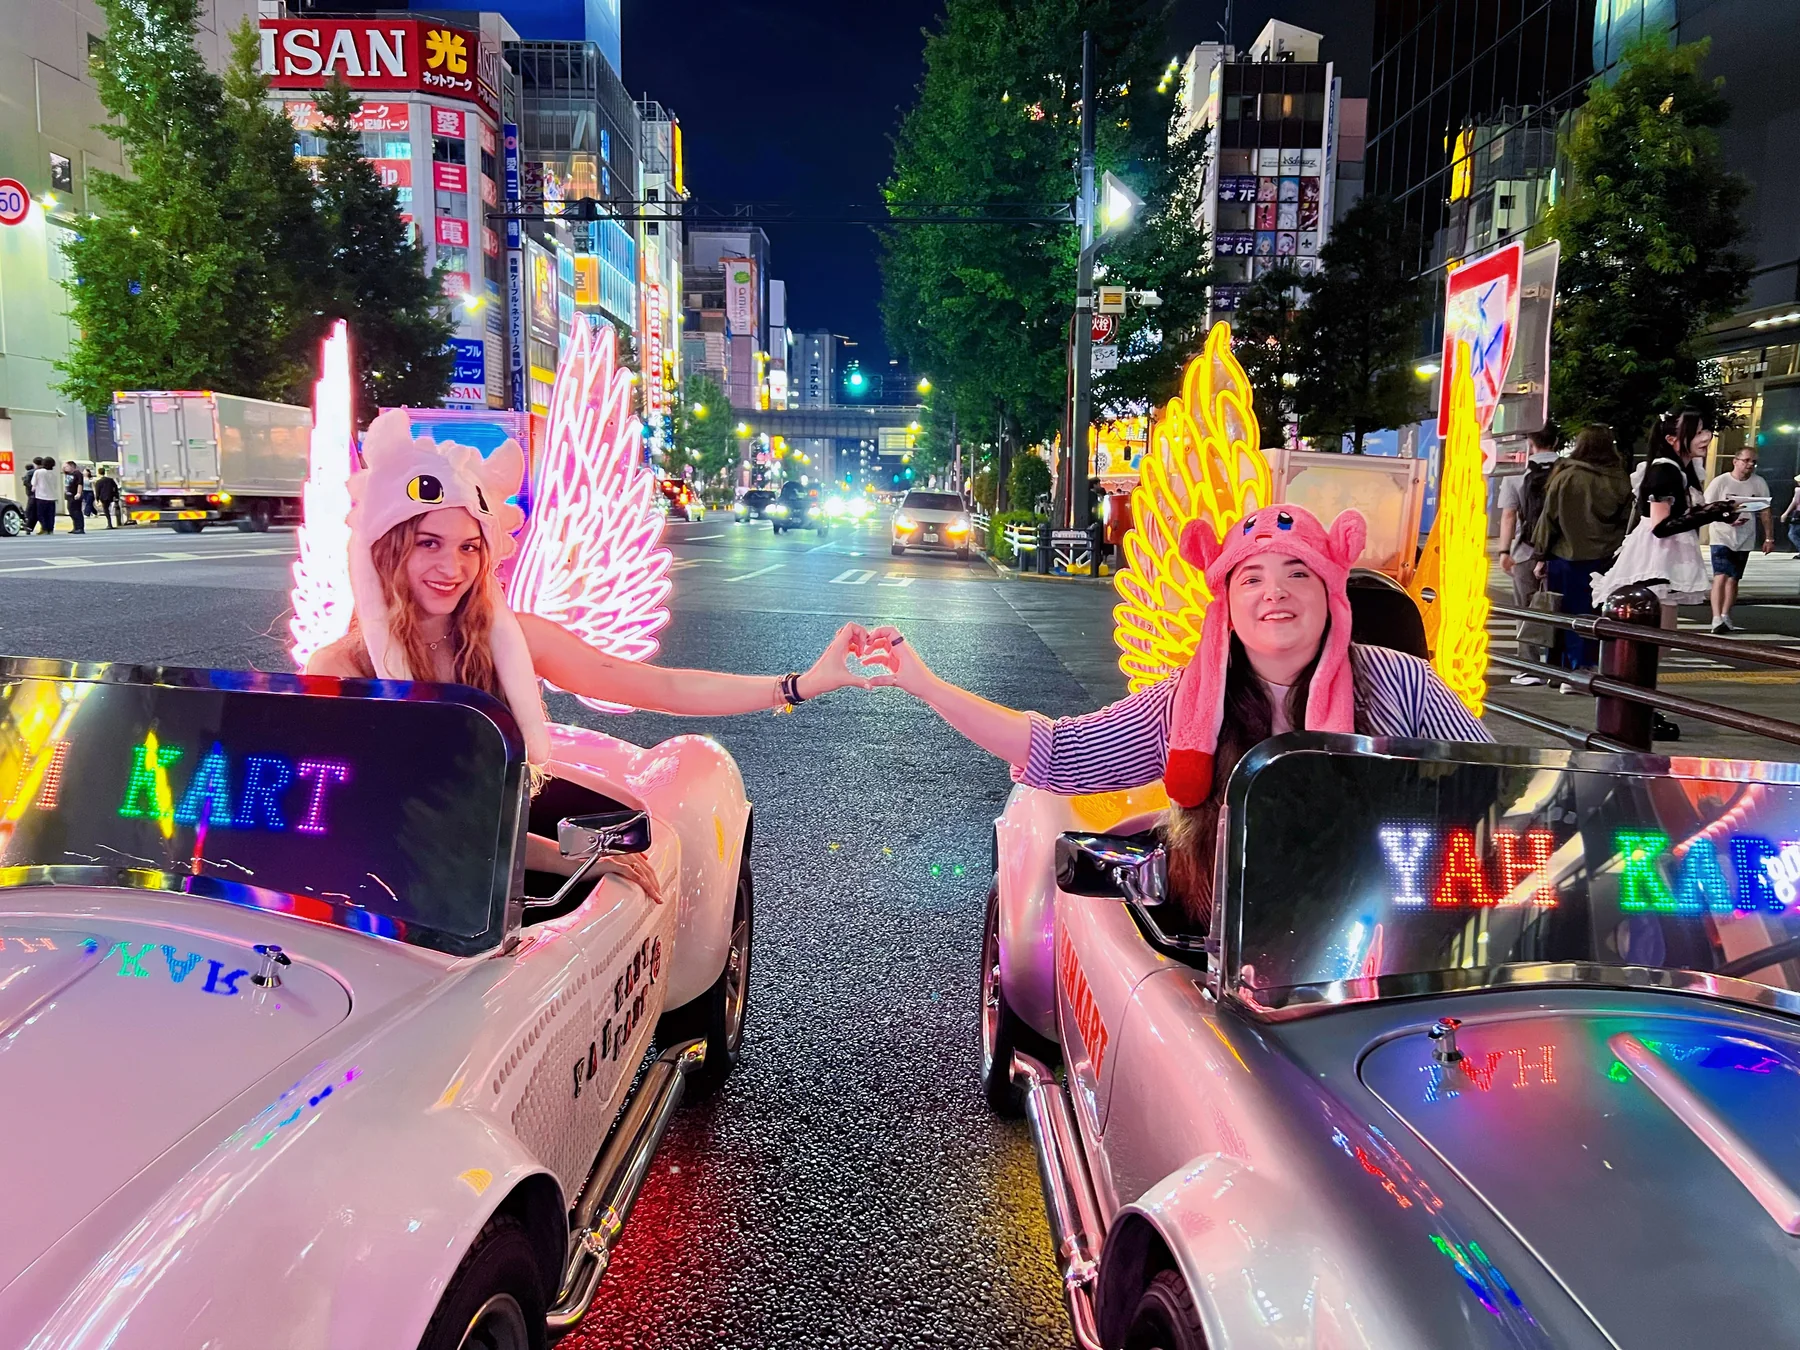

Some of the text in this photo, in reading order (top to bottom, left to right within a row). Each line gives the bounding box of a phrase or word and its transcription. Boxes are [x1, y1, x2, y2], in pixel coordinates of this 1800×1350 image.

[426, 30, 467, 74] 光
[423, 71, 472, 92] ネットワーク
[1239, 189, 1256, 202] 7F
[1235, 242, 1253, 255] 6F
[117, 741, 351, 834] KART
[1379, 828, 1800, 911] YAH KAR
